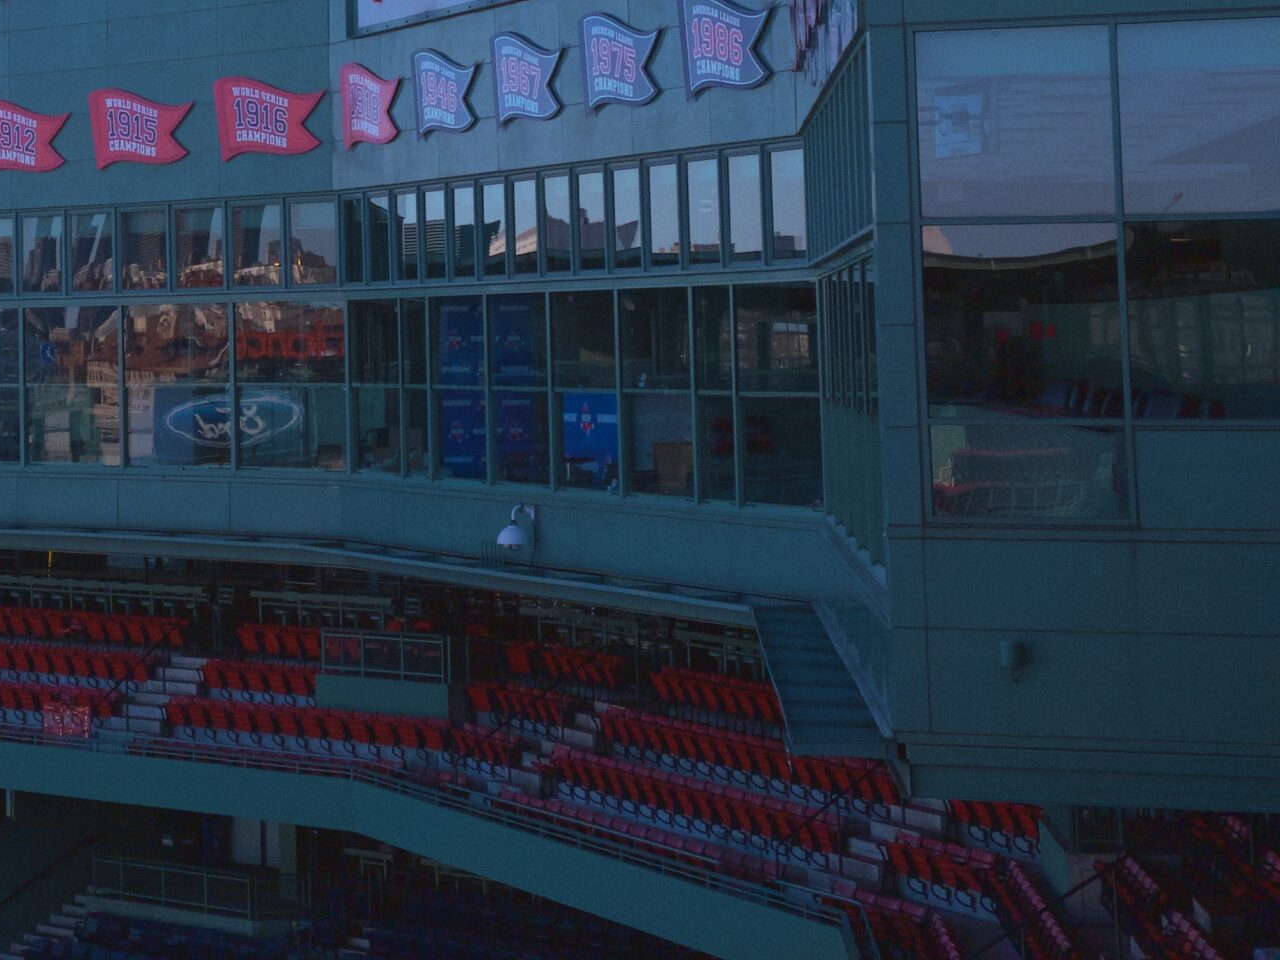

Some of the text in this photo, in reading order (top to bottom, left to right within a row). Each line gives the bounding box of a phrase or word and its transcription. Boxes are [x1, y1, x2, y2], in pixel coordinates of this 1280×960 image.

[693, 5, 740, 27] AMERICAN LEAGUE
[692, 17, 743, 66] 1986
[591, 37, 636, 83] 1975
[696, 59, 740, 81] CHAMPIONS
[501, 56, 541, 100] 1967
[595, 76, 634, 97] CHAMPIONS
[232, 86, 288, 107] WORLD SERIES
[421, 72, 457, 113] 1946
[105, 98, 158, 118] WORLD SERIES
[350, 84, 380, 124] 1918
[13, 113, 37, 129] SERIES
[107, 109, 158, 146] 1915
[234, 98, 288, 136] 1916
[110, 139, 157, 157] CHAMPIONS
[236, 129, 288, 148] CHAMPIONS
